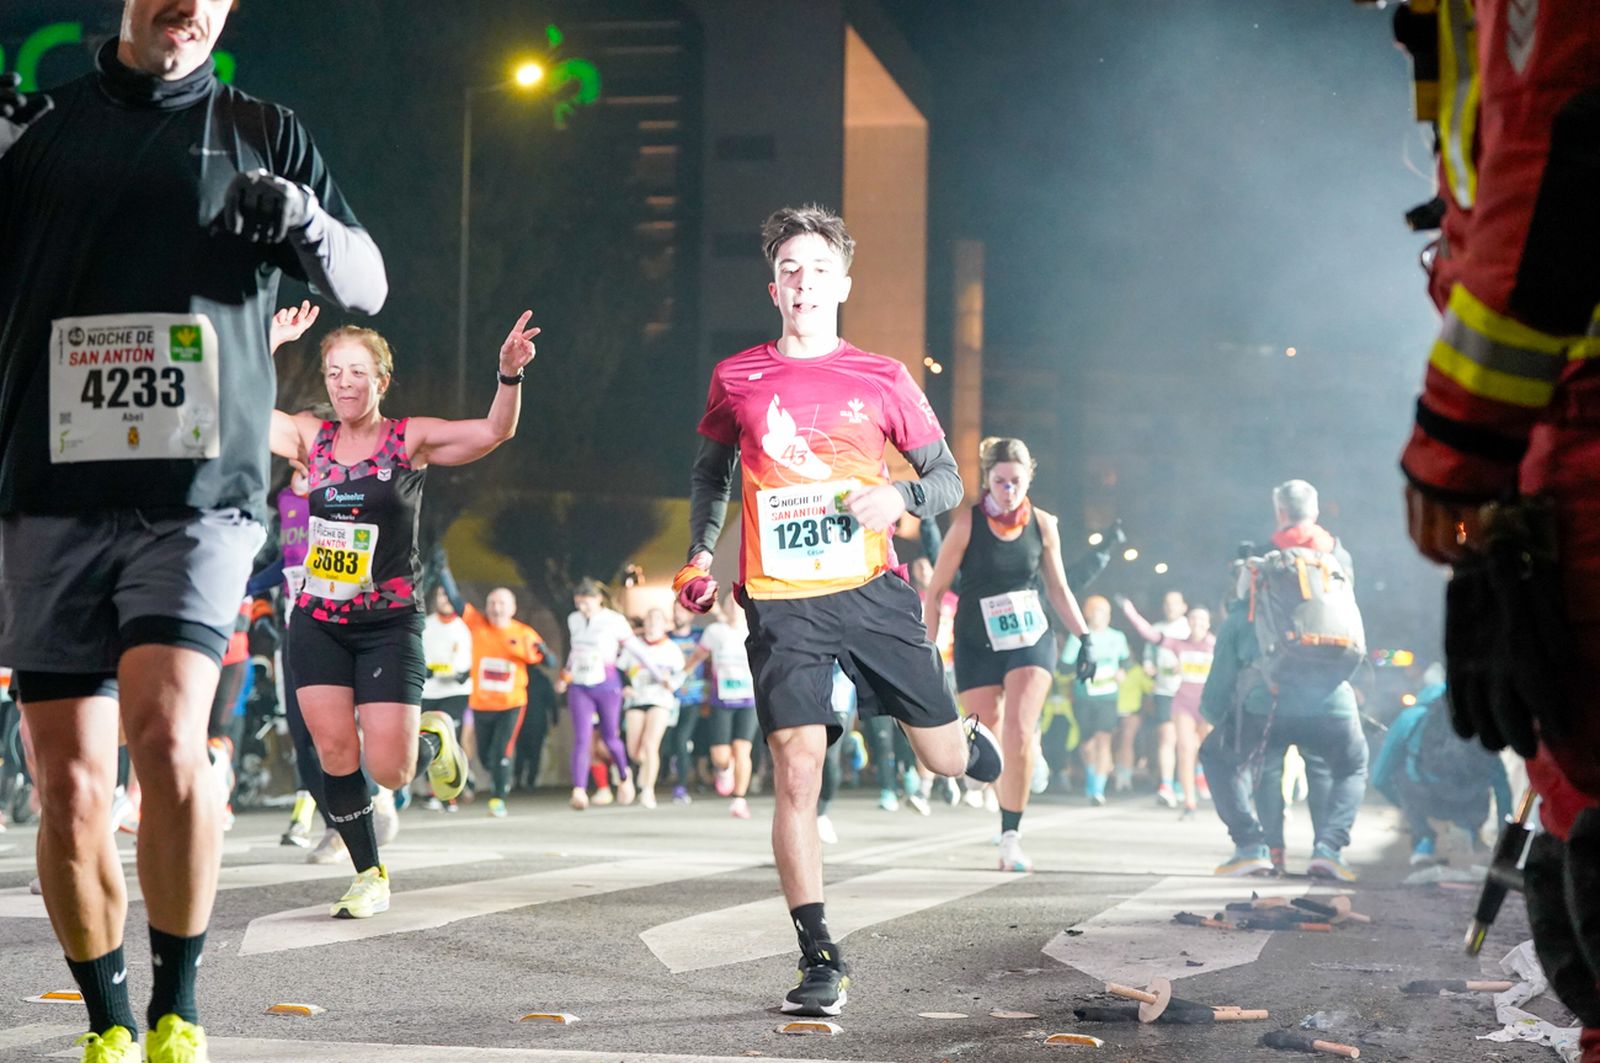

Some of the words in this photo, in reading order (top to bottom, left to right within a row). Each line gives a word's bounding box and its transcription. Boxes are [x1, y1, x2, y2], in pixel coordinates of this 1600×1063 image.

[87, 331, 132, 346] NOCHE
[136, 330, 154, 344] DE
[69, 351, 99, 366] SAN
[80, 367, 185, 410] 4233
[122, 413, 143, 422] Abel
[780, 444, 808, 466] 43
